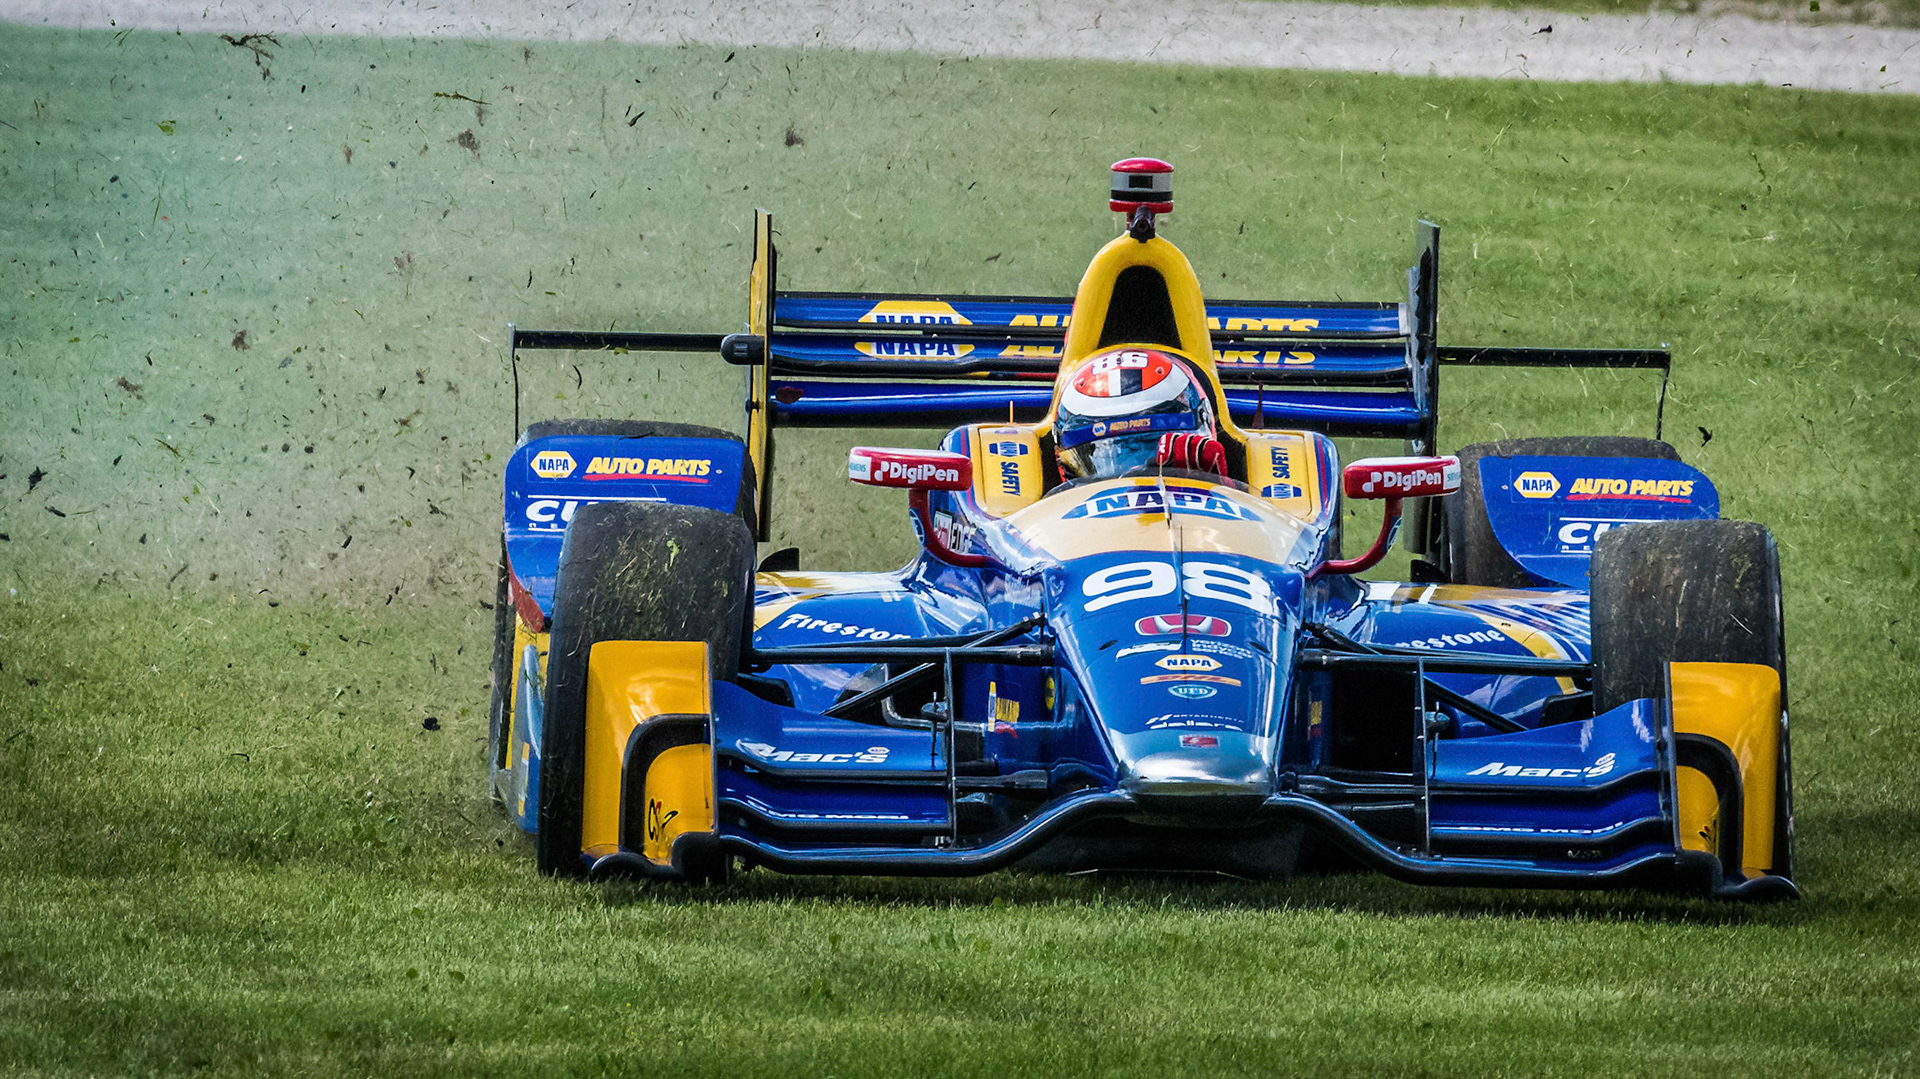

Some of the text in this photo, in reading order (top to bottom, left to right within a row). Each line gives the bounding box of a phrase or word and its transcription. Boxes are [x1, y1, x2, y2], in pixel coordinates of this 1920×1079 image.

[1110, 421, 1128, 430] AUTO
[1129, 418, 1150, 428] PARTS
[539, 457, 711, 475] NAPA AUTO PARTS
[890, 462, 959, 484] DigiPen
[1271, 446, 1290, 479] SAFETY
[1001, 461, 1021, 496] SAFETY
[1383, 470, 1441, 491] DigiPen
[1522, 478, 1694, 496] NAPA AUTO PARTS
[1096, 492, 1236, 515] NAPA
[1082, 561, 1273, 615] 98
[1167, 659, 1212, 667] NAPA
[740, 740, 888, 763] Mac's
[1466, 760, 1616, 777] Mac's
